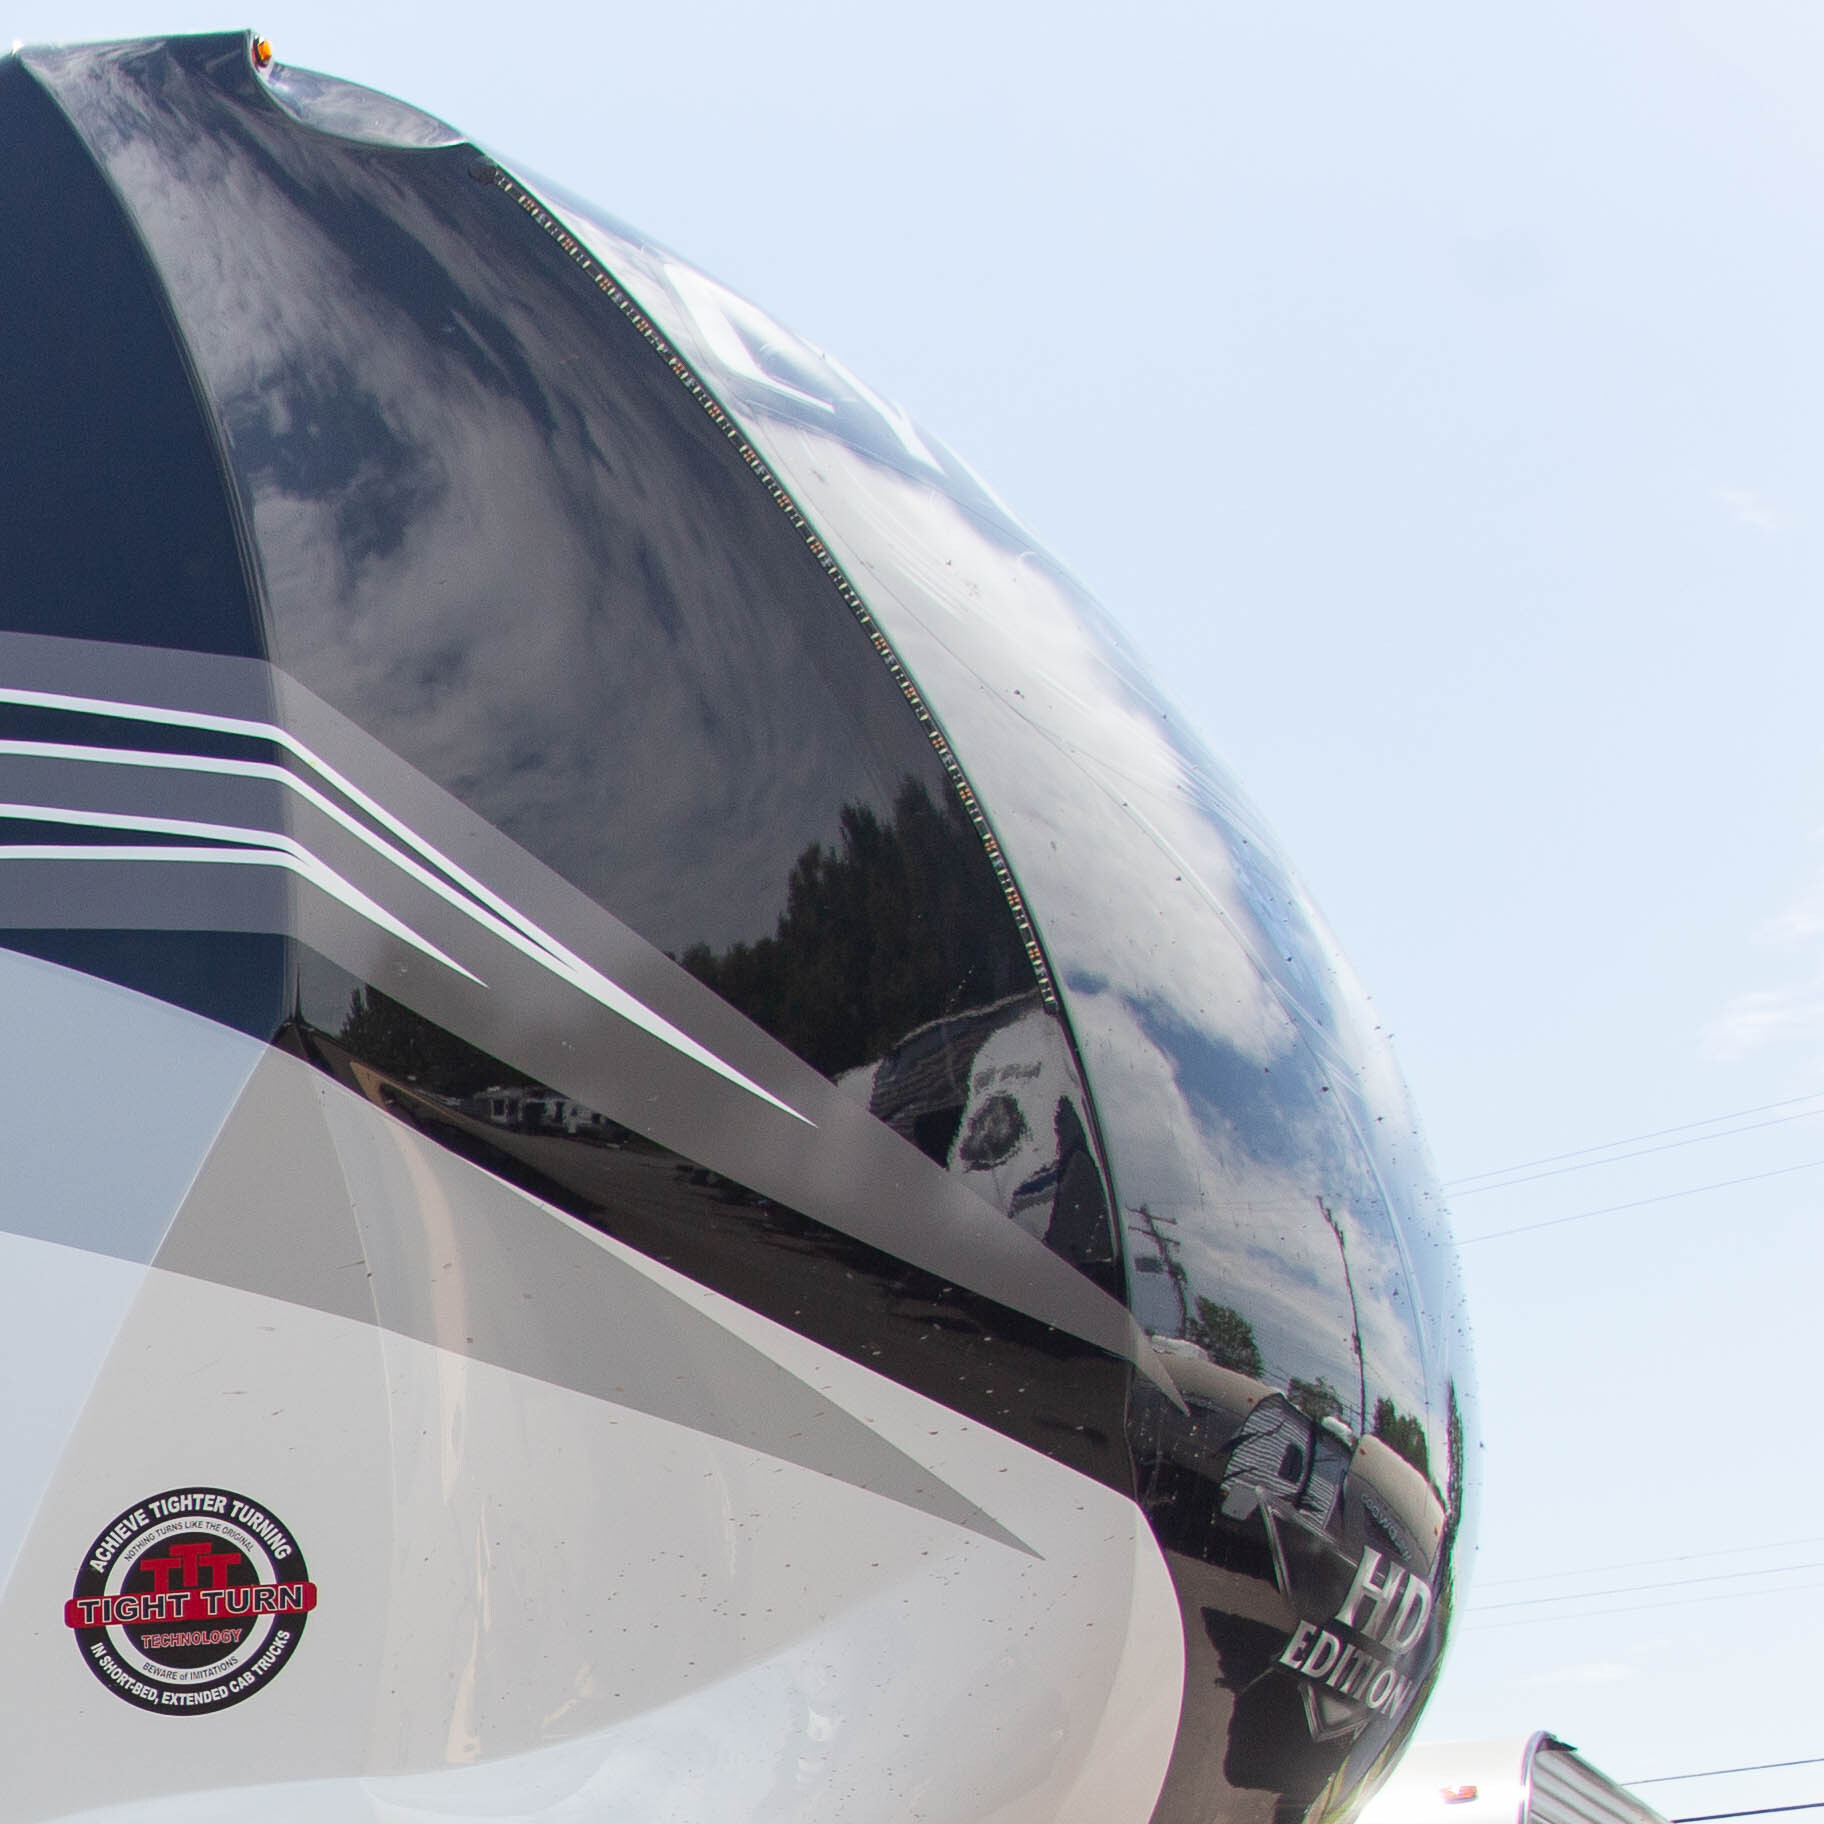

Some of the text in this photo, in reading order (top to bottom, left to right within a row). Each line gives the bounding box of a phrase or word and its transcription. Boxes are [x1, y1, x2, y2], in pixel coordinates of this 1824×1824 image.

[90, 1494, 292, 1574] ACHIEVE TIGHTER TURNING
[123, 1520, 255, 1562] NOTHING TURNS LIKE THE ORIGINAL
[76, 1584, 304, 1624] TIGHT TURN
[1334, 1545, 1433, 1656] HD
[90, 1630, 291, 1706] IN SHORT-BED, EXTENDED CAB TRUCKS
[141, 1628, 243, 1649] TECHNOLOGY
[142, 1656, 239, 1681] BEWARE of IMITATIONS
[1280, 1619, 1413, 1720] EDITION
